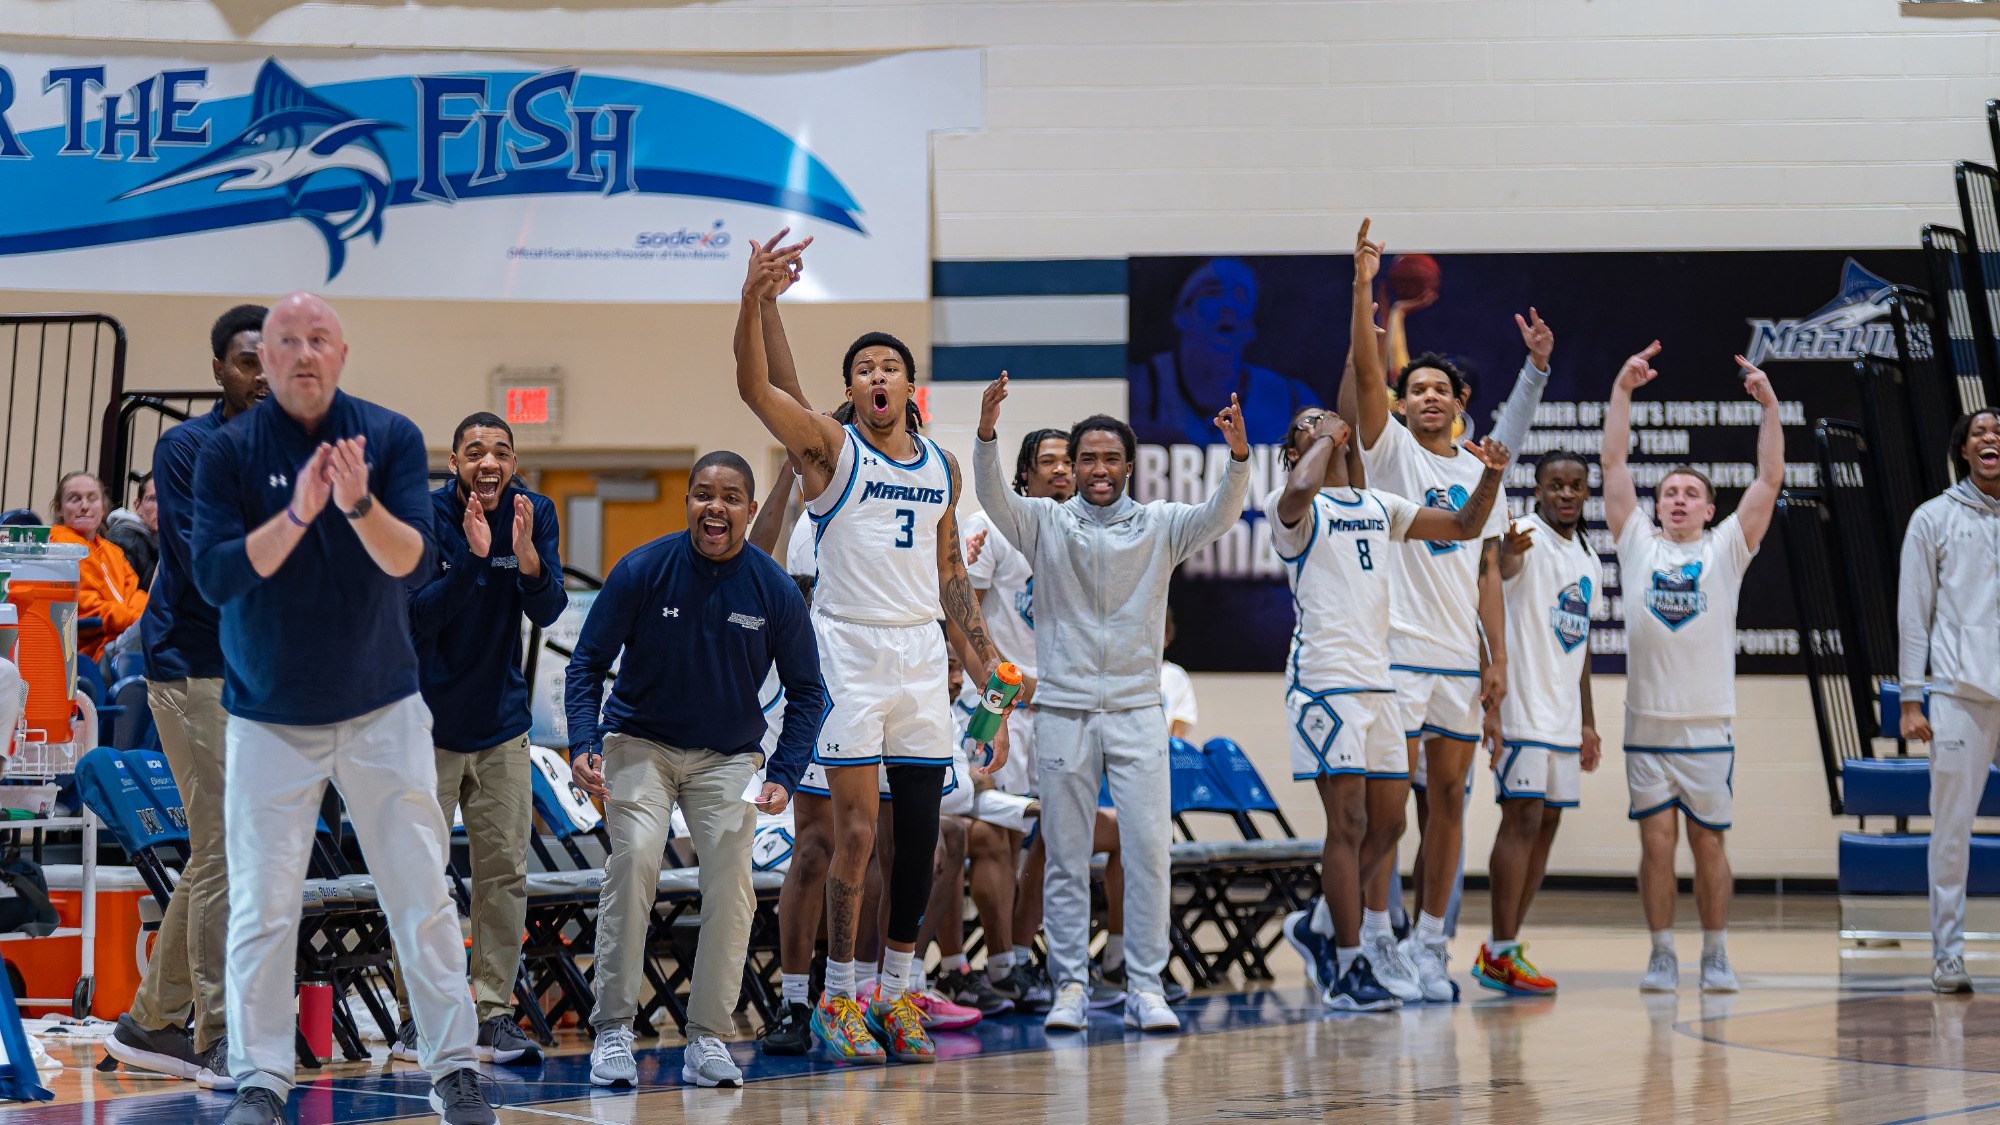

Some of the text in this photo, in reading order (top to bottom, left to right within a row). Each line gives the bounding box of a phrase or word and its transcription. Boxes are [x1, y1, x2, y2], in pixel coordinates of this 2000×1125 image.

[41, 65, 211, 163] THE
[411, 65, 642, 206] FISH
[1640, 429, 1690, 455] TEAM
[895, 508, 915, 548] 3
[1356, 538, 1373, 570] 8
